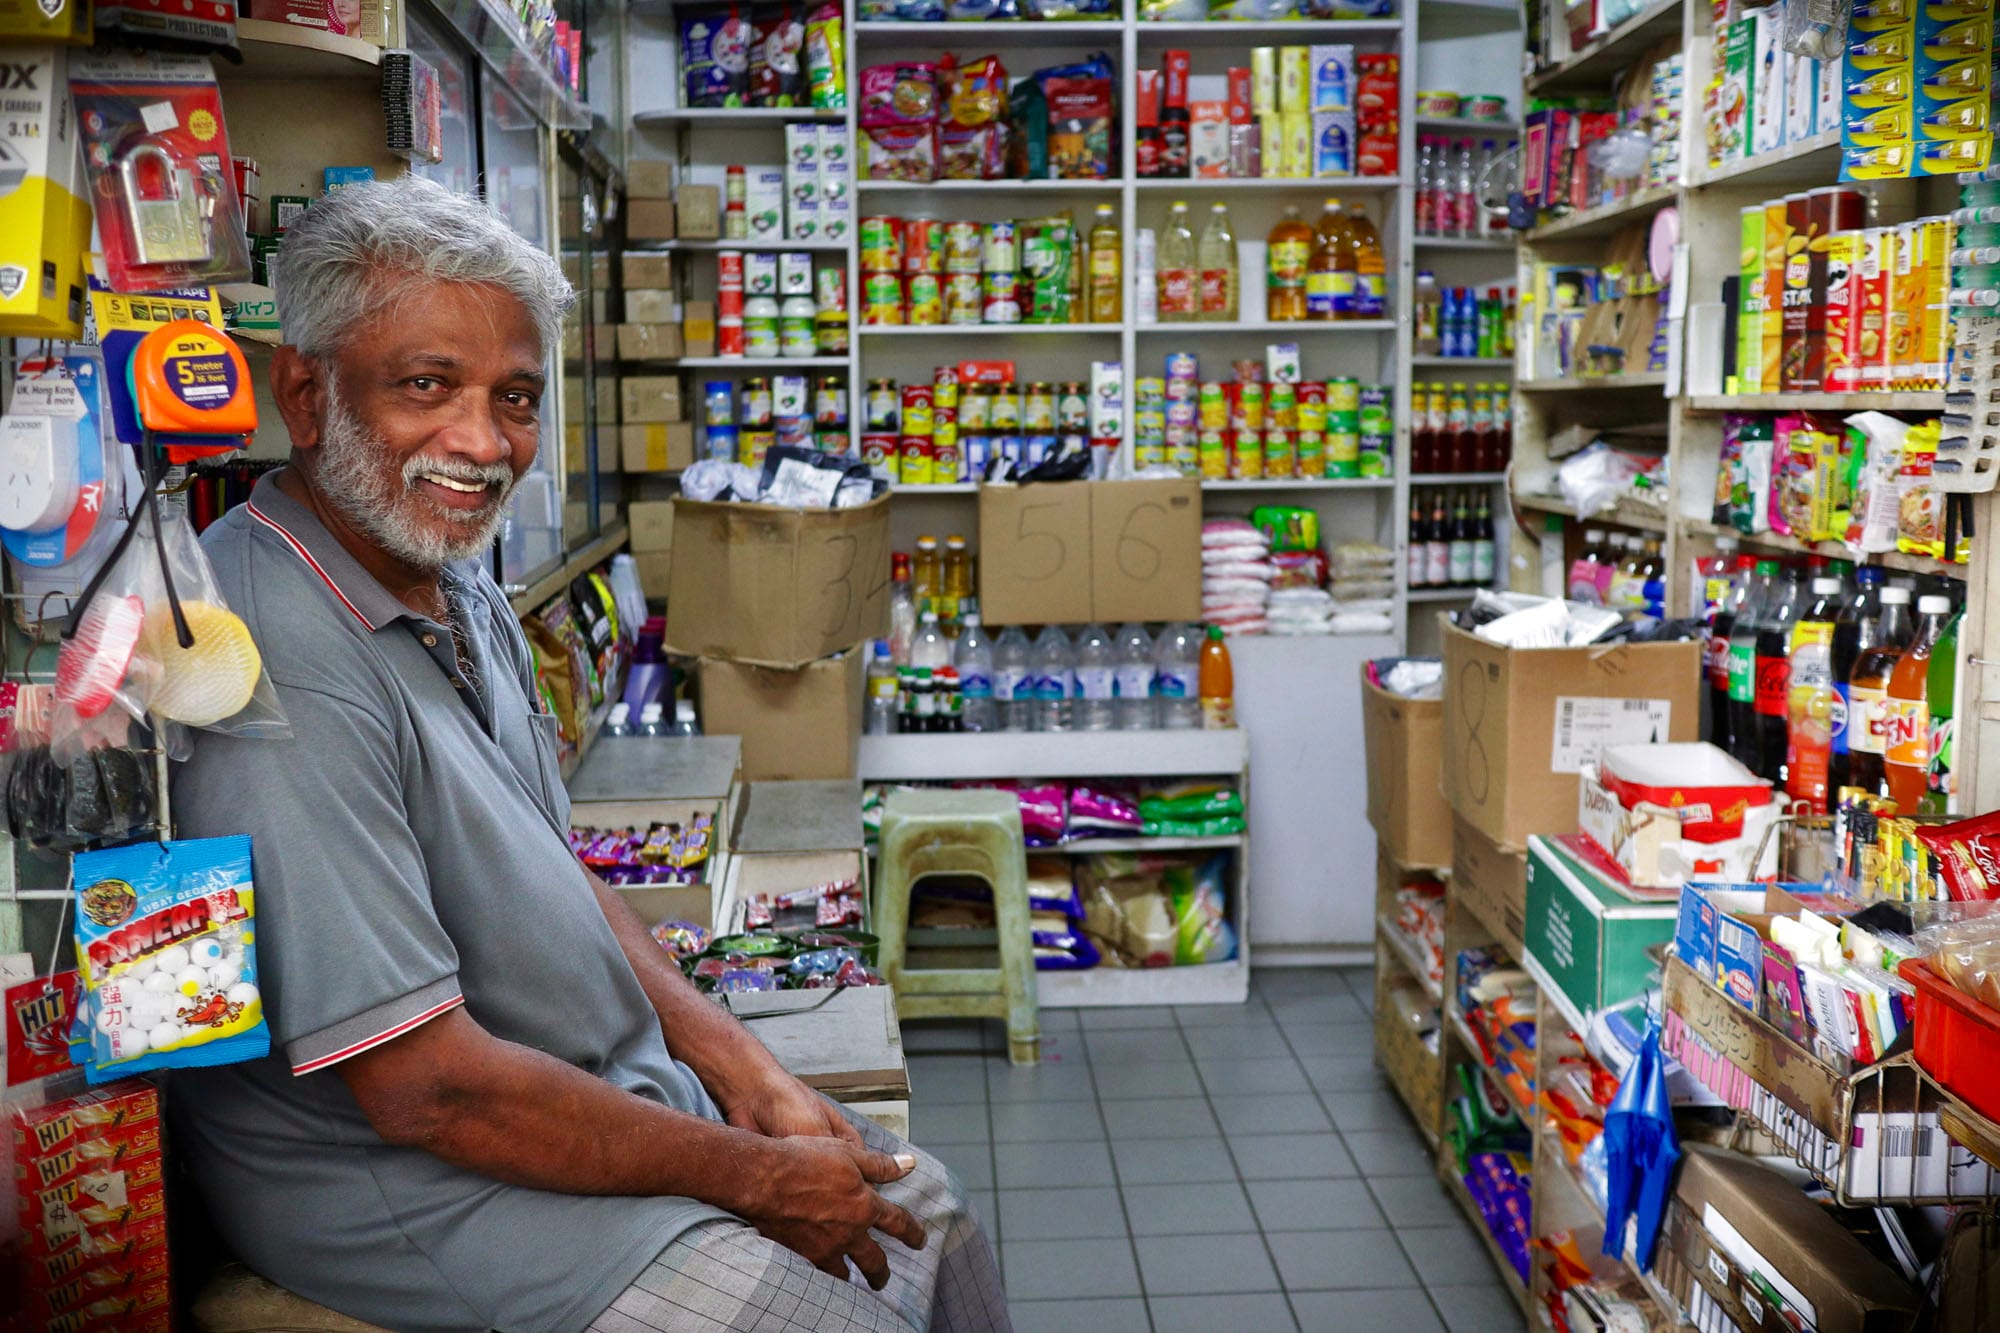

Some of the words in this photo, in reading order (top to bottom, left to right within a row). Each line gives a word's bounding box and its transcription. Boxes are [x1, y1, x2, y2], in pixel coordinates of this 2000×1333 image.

[168, 19, 229, 39] PROTECTION
[178, 287, 208, 300] TAPE
[177, 342, 206, 352] DIY
[176, 360, 195, 385] 5
[192, 361, 225, 371] meter
[207, 373, 228, 382] feet
[31, 385, 53, 397] Hong
[54, 384, 75, 396] Kong
[54, 397, 75, 406] more
[1015, 503, 1066, 582] 5
[1116, 503, 1167, 581] 6
[20, 990, 65, 1034] HIT
[37, 1115, 74, 1149] HIT
[39, 1151, 76, 1185] HIT
